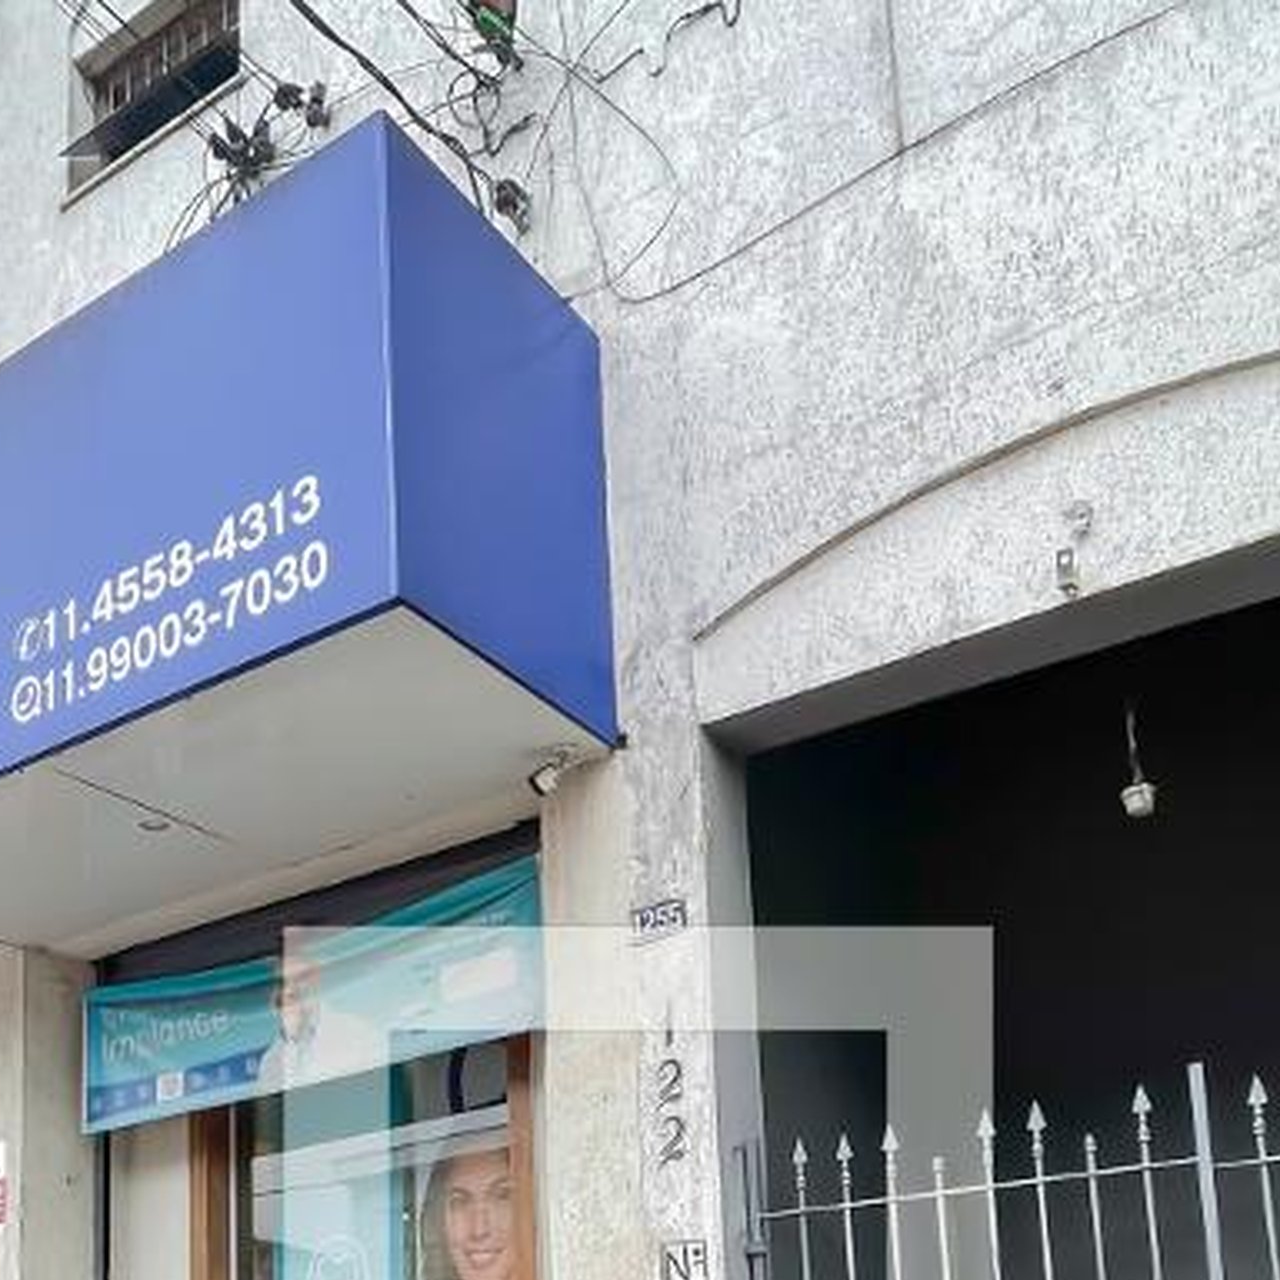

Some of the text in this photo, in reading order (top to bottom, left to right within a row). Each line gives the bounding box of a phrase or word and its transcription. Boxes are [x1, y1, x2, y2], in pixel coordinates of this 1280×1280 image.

[43, 475, 321, 649] 11.4558-4313
[45, 540, 328, 710] 11.99003-7030
[634, 902, 683, 935] 1255
